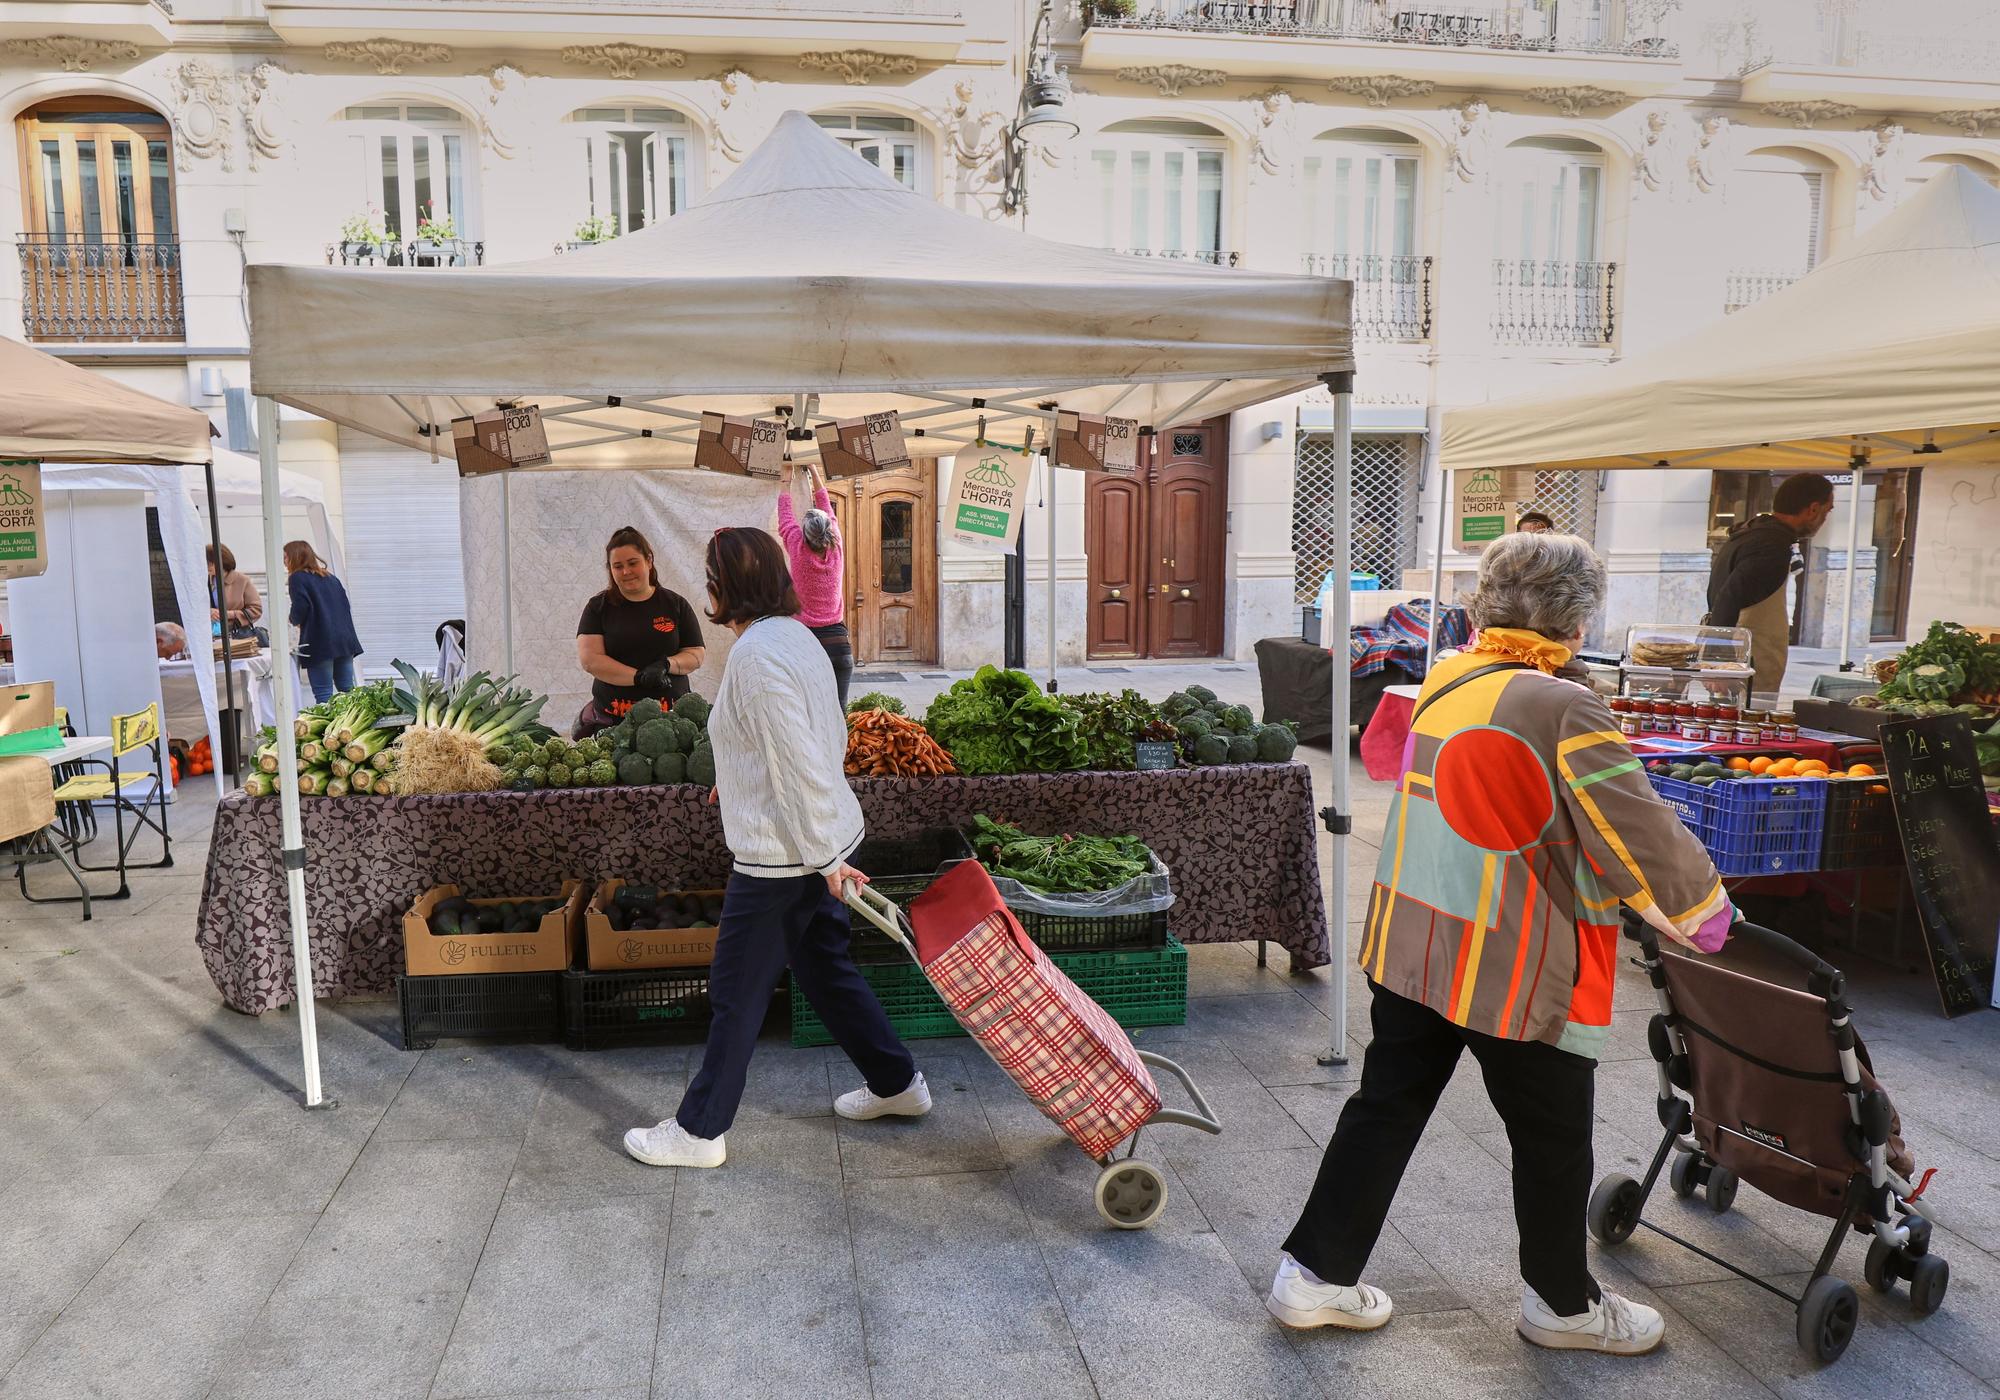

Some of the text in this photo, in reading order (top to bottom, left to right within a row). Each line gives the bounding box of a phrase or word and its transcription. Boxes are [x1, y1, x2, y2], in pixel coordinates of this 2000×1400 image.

[507, 415, 530, 430] 2023
[868, 419, 892, 435] 2023
[753, 428, 776, 443] 2023
[1107, 425, 1128, 439] 2023
[963, 481, 1013, 498] Mercats de
[961, 490, 1011, 508] L'HORTA
[1463, 495, 1493, 503] Mercats
[23, 507, 33, 516] de
[1463, 502, 1505, 513] L'HORTA
[959, 516, 984, 527] DIRECTA
[985, 521, 995, 529] DEL
[979, 513, 999, 522] VENDA
[13, 537, 32, 545] ÁNGEL
[17, 545, 35, 553] PÉREZ
[1944, 764, 1971, 785] MARE
[471, 944, 537, 957] FULLETES
[647, 943, 713, 955] FULLETES
